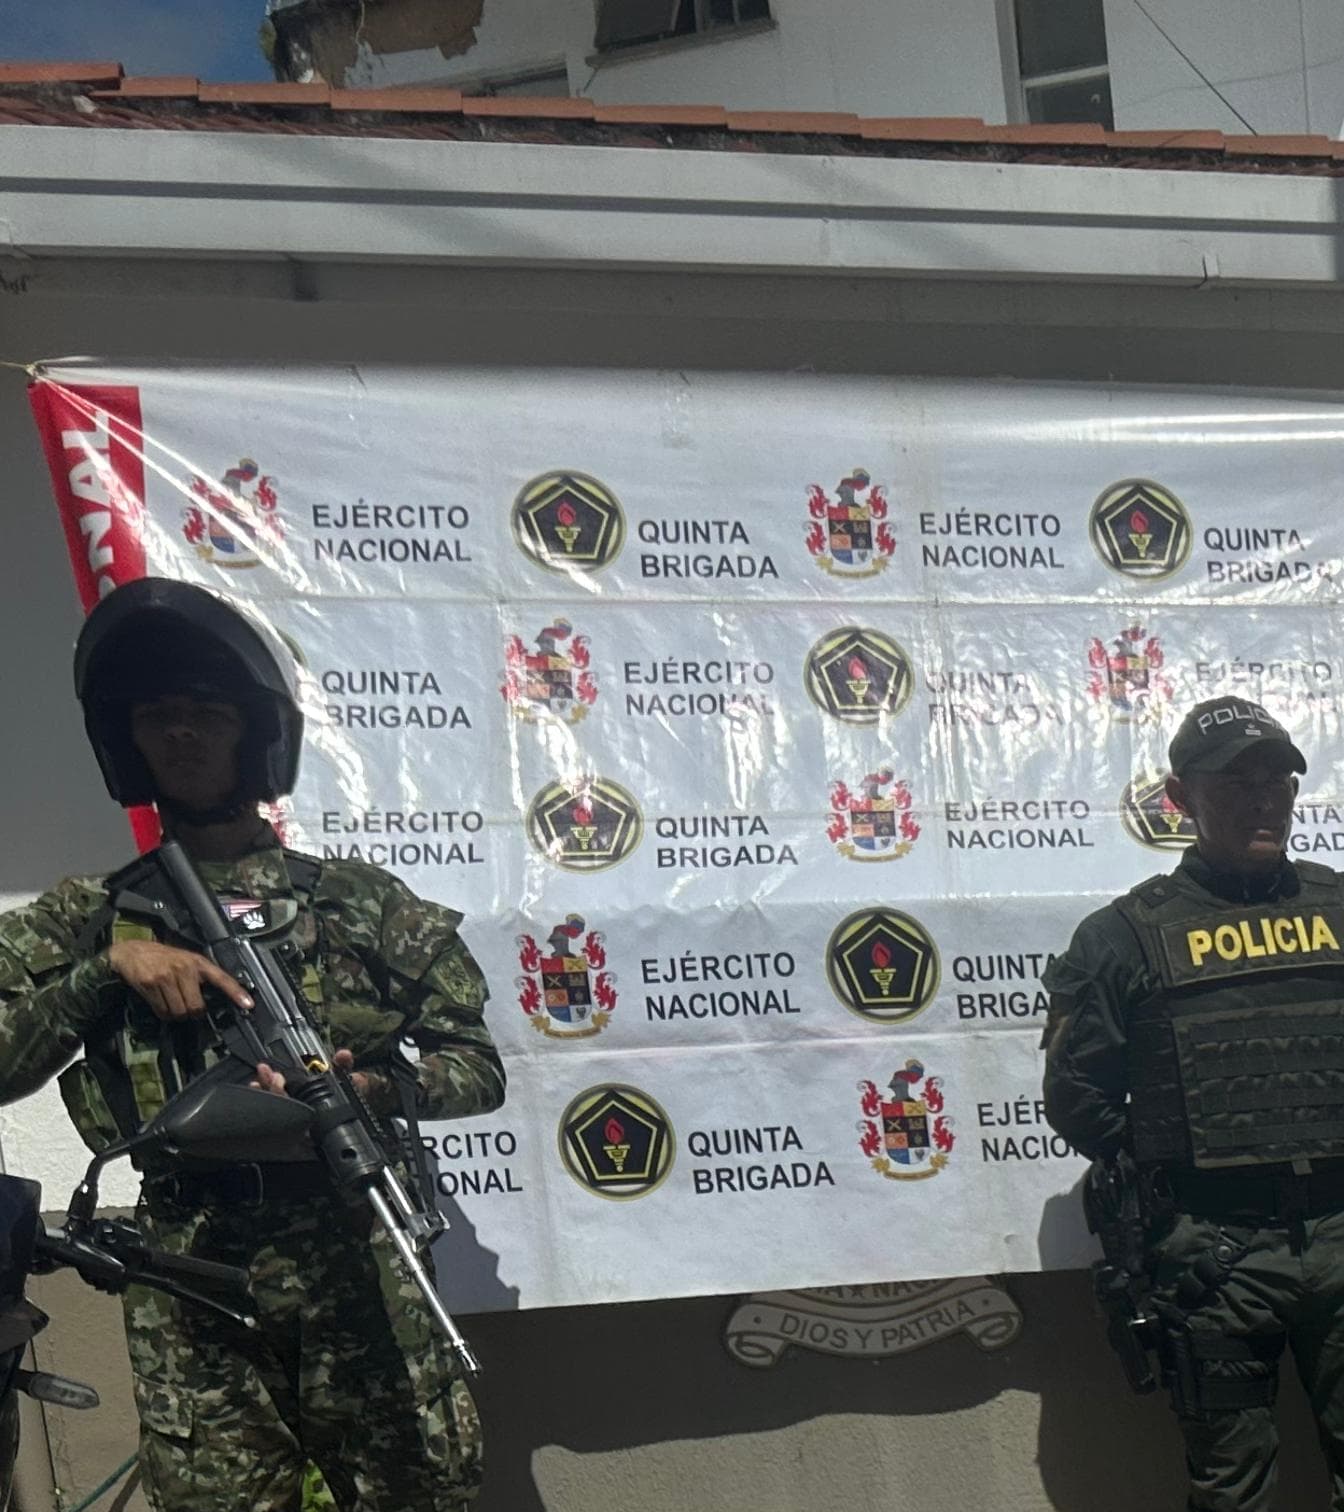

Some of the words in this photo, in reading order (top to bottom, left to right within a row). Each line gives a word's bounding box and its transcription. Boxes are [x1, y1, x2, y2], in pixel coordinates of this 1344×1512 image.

[312, 499, 469, 529] EJÉRCITO
[919, 510, 1061, 537] EJÉRCITO
[638, 519, 749, 546] QUINTA
[1204, 527, 1304, 553] QUINTA
[314, 538, 472, 563] NACIONAL
[921, 543, 1064, 570] NACIONAL
[640, 553, 779, 580] BRIGADA
[1207, 560, 1332, 583] BRIGADA
[322, 670, 441, 696] QUINTA
[624, 656, 774, 686] EJÉRCITO
[327, 706, 472, 729] BRIGADA
[322, 806, 483, 834] EJÉRCITO
[944, 796, 1089, 822] EJÉRCITO
[655, 816, 768, 839] QUINTA
[947, 829, 1094, 849] NACIONAL
[322, 843, 484, 865] NACIONAL
[657, 844, 798, 867] BRIGADA
[1188, 916, 1340, 966] POLICIA
[641, 951, 795, 984] EJÉRCITO
[645, 989, 800, 1020] NACIONAL
[957, 990, 1050, 1019] BRIGA
[978, 1094, 1047, 1127] EJÉR
[421, 1131, 516, 1160] RCITO
[688, 1125, 803, 1157] QUINTA
[981, 1134, 1080, 1162] NACIO
[438, 1168, 523, 1198] ONAL
[693, 1161, 835, 1195] BRIGADA
[779, 1313, 848, 1350] DIOS
[853, 1329, 872, 1349] Y
[881, 1299, 975, 1349] PATRIA
